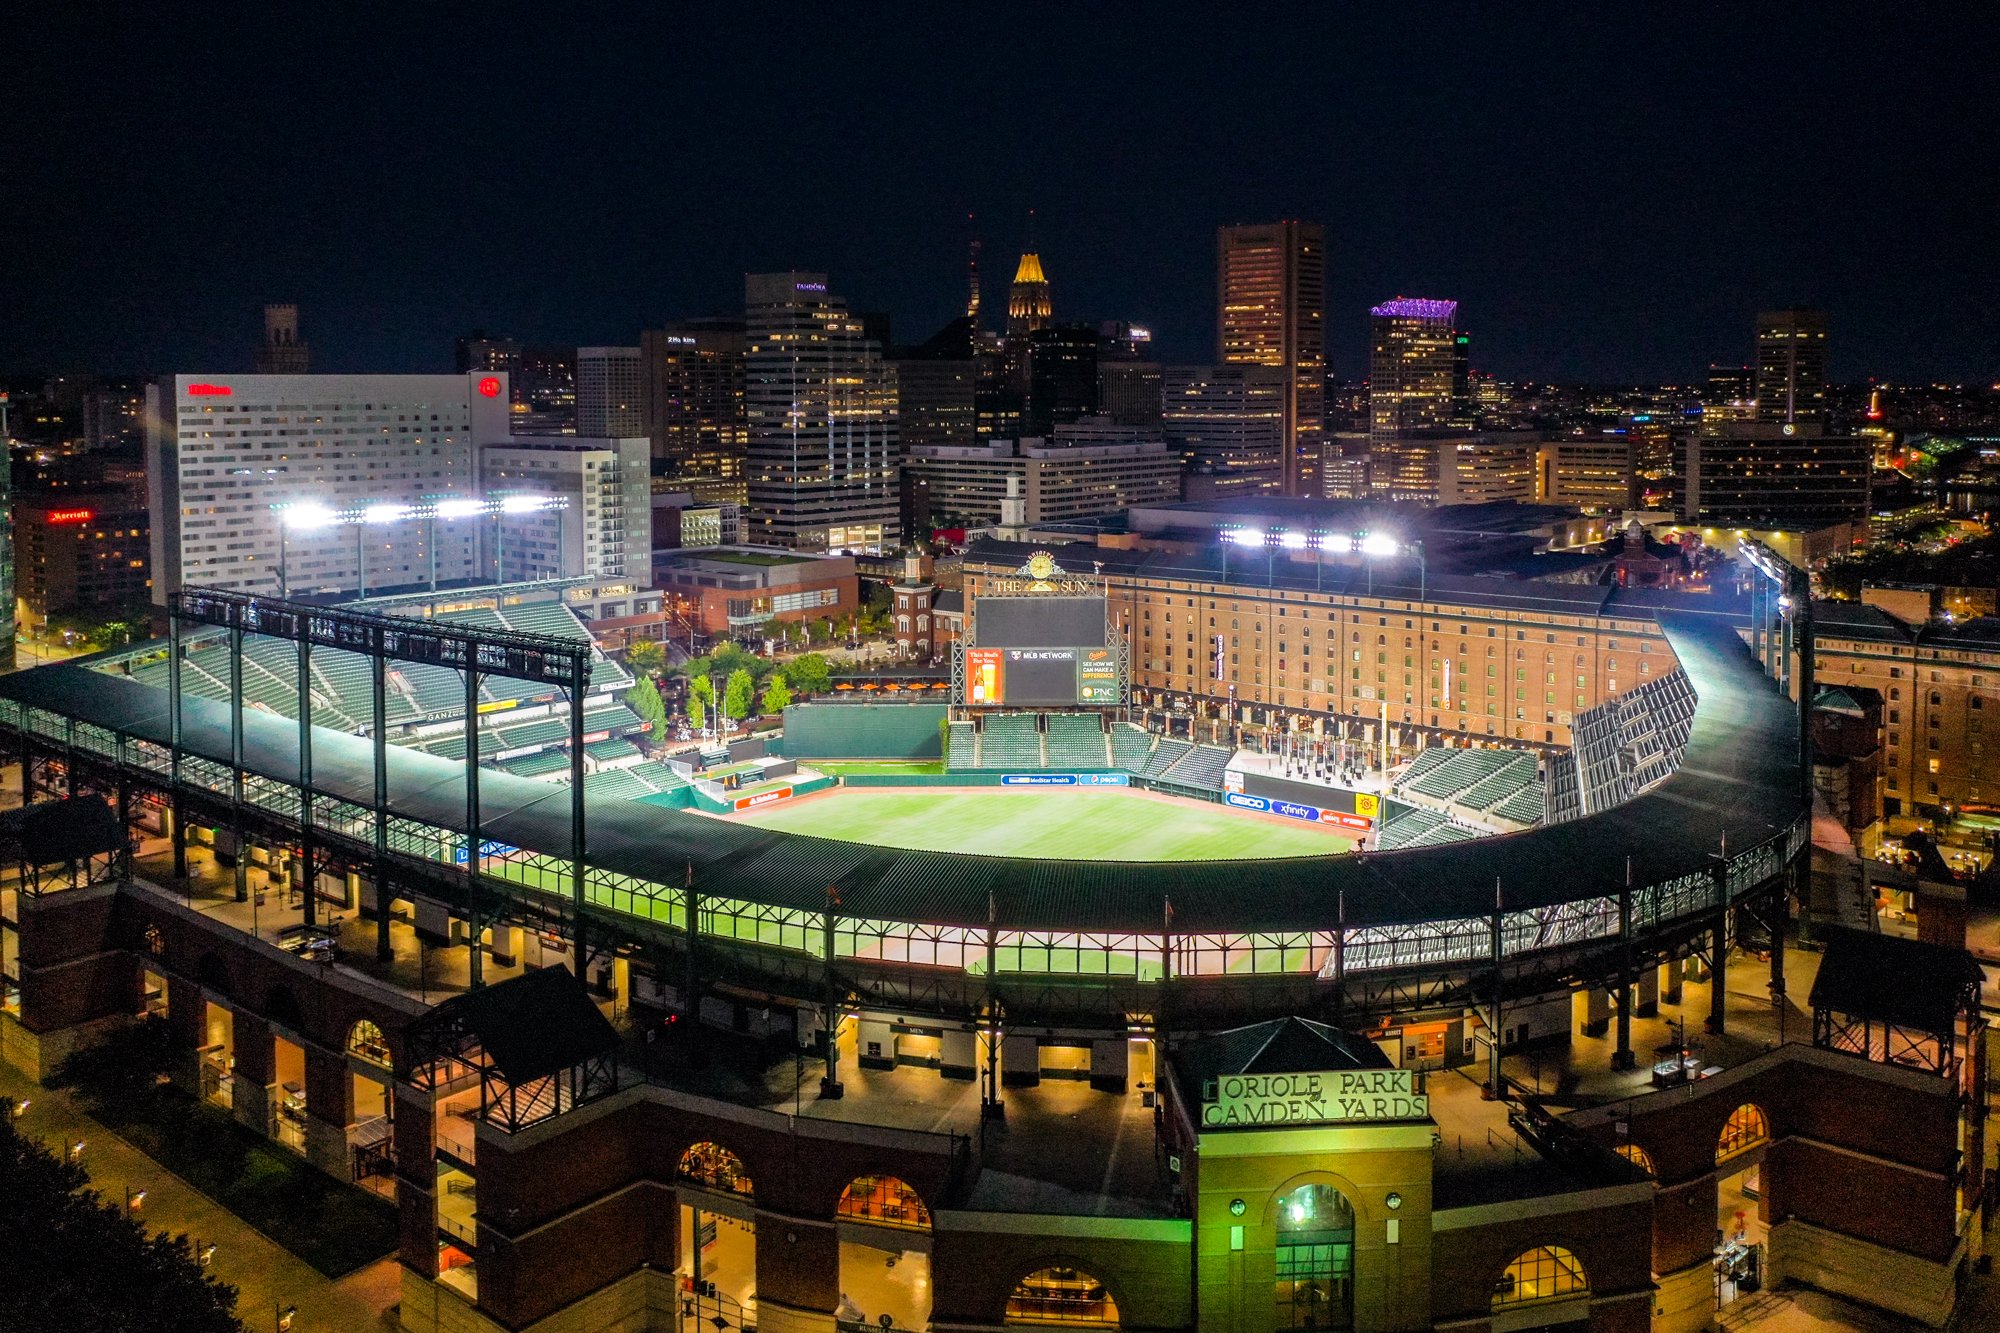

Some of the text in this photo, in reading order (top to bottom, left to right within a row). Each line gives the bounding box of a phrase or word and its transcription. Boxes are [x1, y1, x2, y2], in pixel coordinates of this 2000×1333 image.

[52, 511, 89, 521] Marriott
[995, 581, 1087, 592] THE SUN
[1093, 688, 1114, 697] PNC
[1099, 777, 1119, 785] pepsi
[1229, 796, 1265, 810] GEICO
[1280, 804, 1310, 819] xfinity
[1224, 1071, 1409, 1099] ORIOLE PARK
[1204, 1097, 1425, 1125] CAMDEN YARDS
